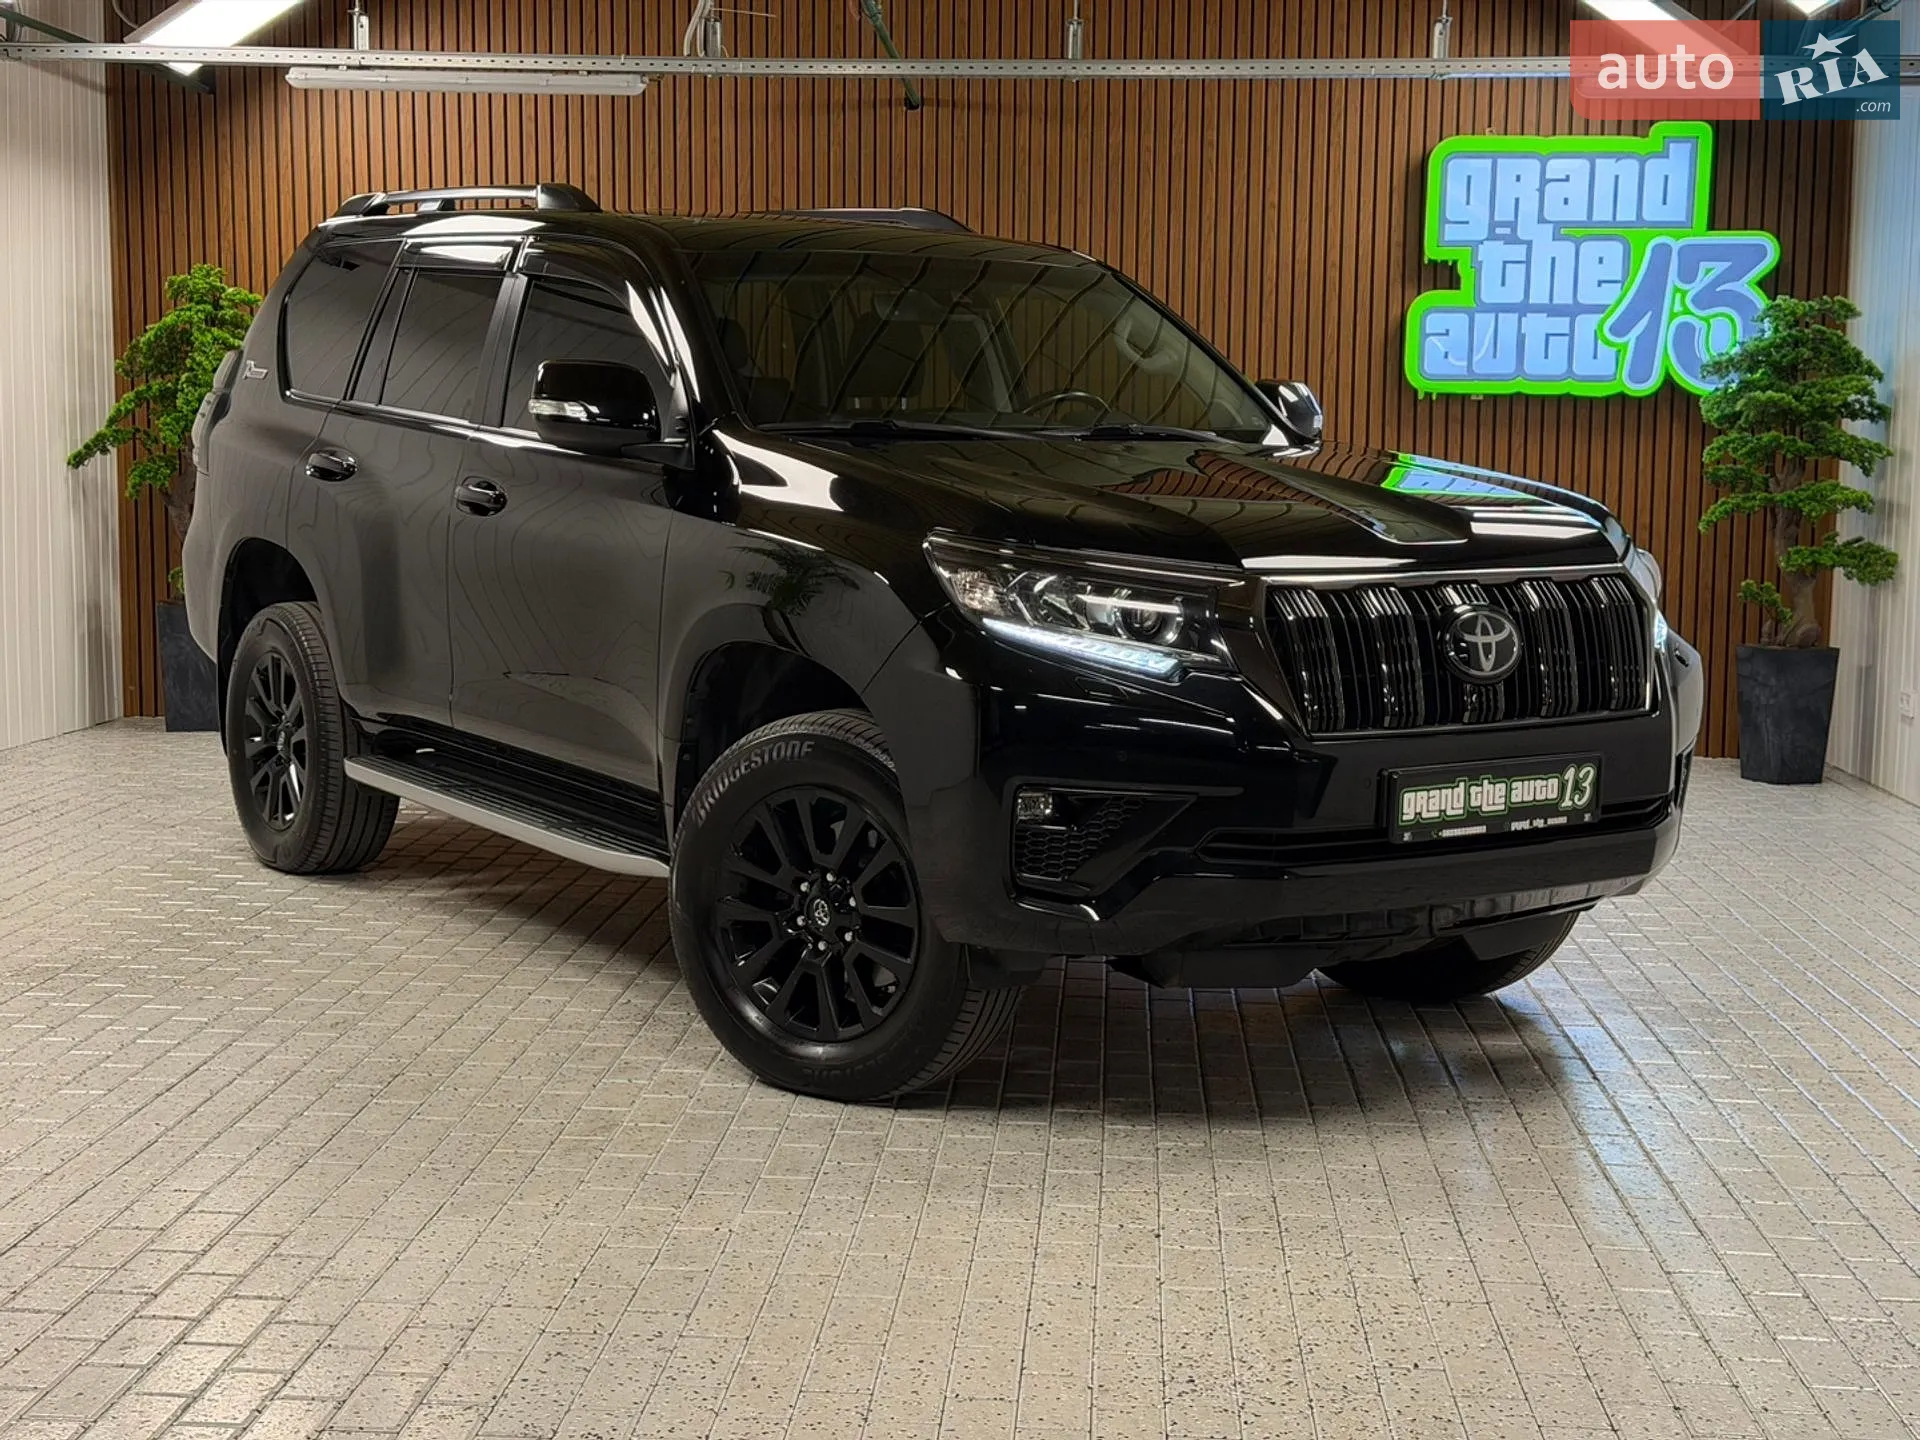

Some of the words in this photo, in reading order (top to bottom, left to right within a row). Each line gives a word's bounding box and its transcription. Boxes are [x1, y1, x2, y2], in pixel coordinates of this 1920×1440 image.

[1444, 141, 1694, 241] grand
[1477, 223, 1624, 305] the
[1423, 312, 1617, 377] auto
[1603, 236, 1773, 391] 13
[690, 739, 816, 830] BRIDGESTONE
[1401, 781, 1466, 821] grand
[1469, 778, 1507, 812] the
[1510, 778, 1560, 804] auto
[1560, 765, 1595, 809] 13
